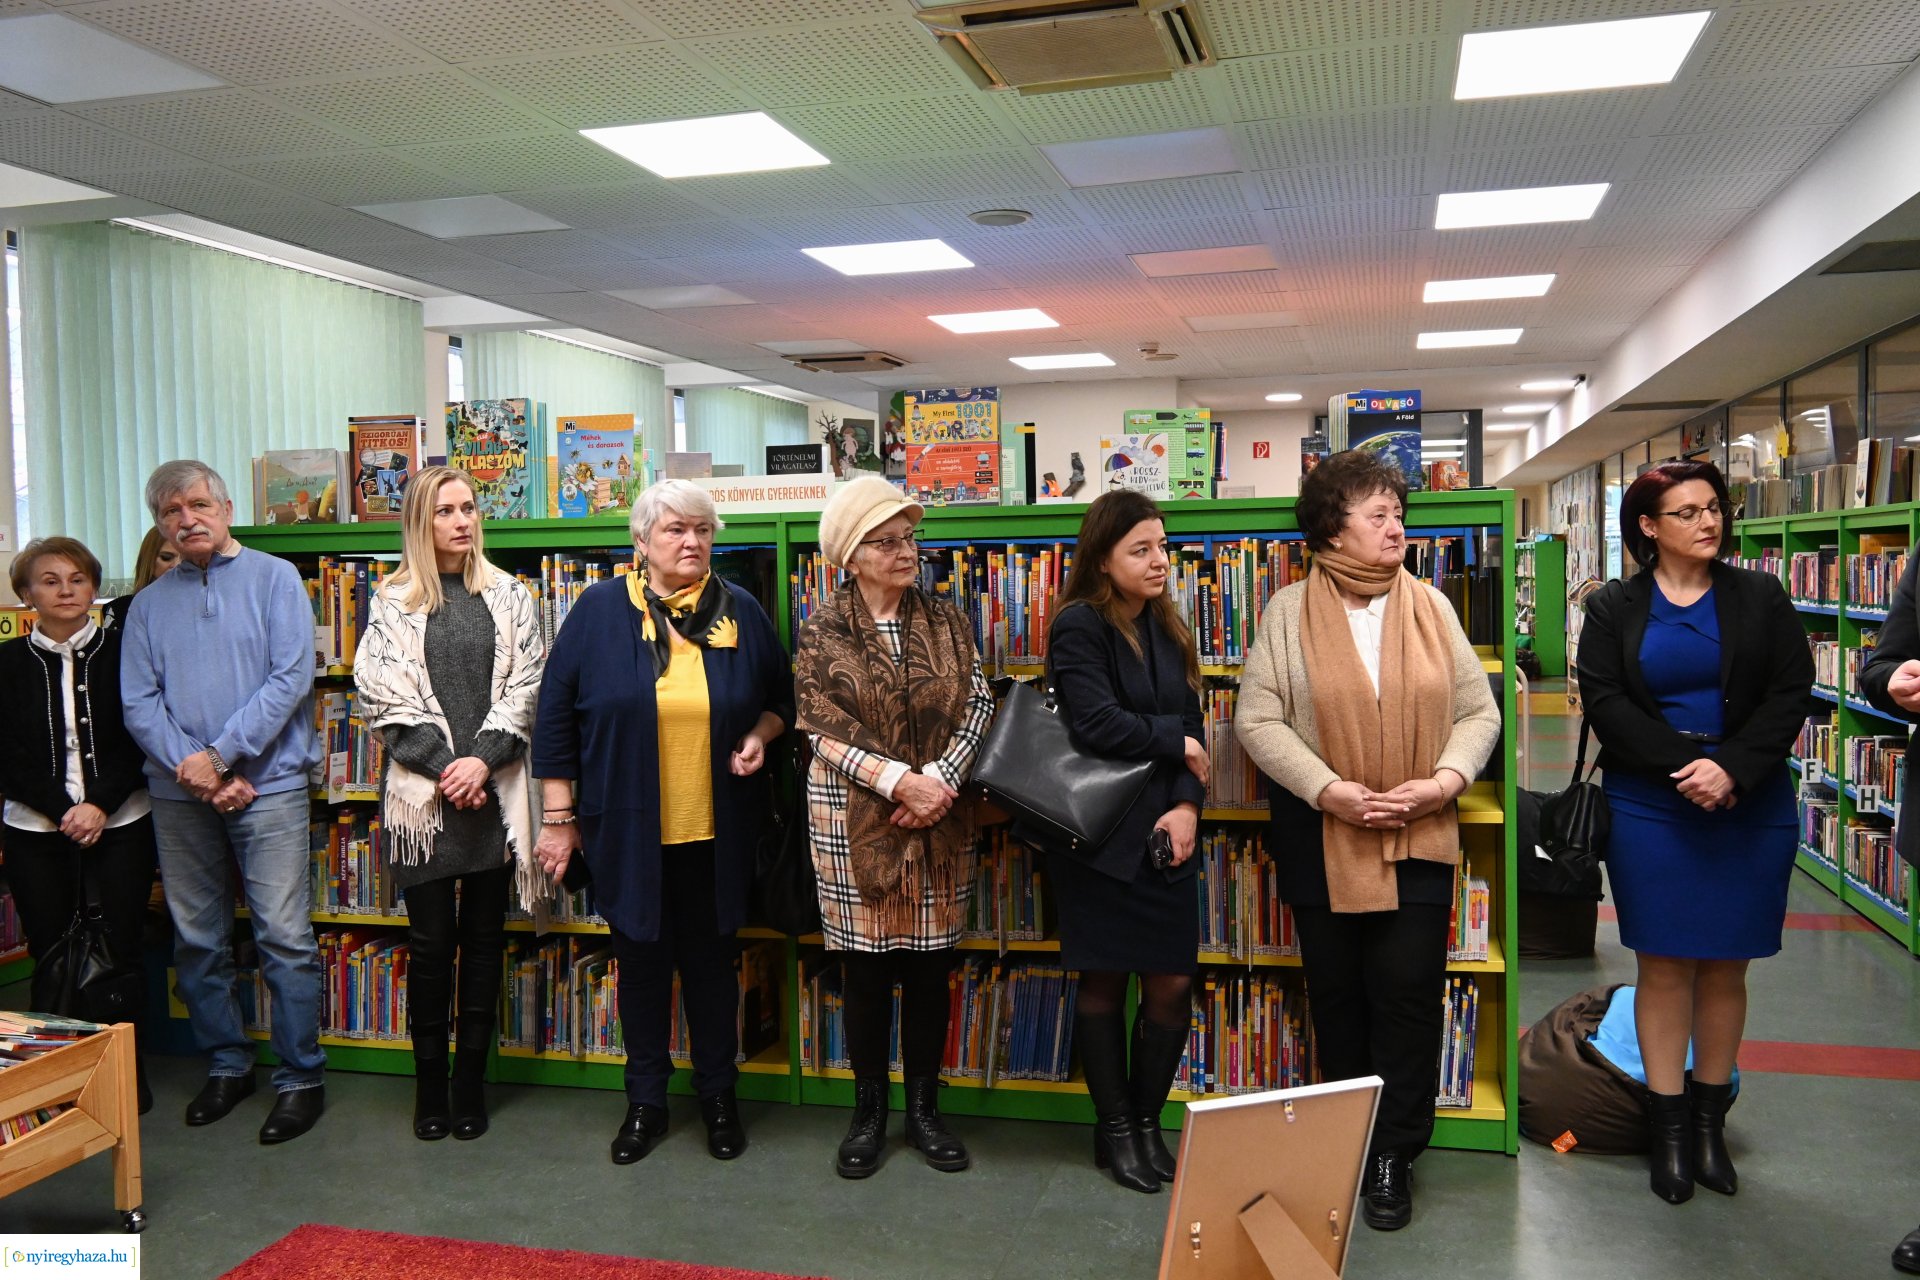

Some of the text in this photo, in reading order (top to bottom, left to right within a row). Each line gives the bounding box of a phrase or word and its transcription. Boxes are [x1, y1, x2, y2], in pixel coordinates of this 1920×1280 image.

[1355, 397, 1414, 410] Mi OLVASÓ
[932, 410, 942, 418] My
[955, 403, 992, 418] 1001
[565, 422, 576, 431] Mi
[910, 417, 993, 441] WORDS
[360, 437, 408, 448] TITKOS!
[595, 441, 625, 449] darazsak
[772, 453, 816, 462] TÖRTÉNELMI
[770, 462, 817, 471] VILÁGATLASZ
[727, 486, 766, 503] KÖNYVEK
[767, 485, 827, 502] GYEREKEKNEK
[1805, 761, 1816, 781] F
[1860, 788, 1876, 810] H
